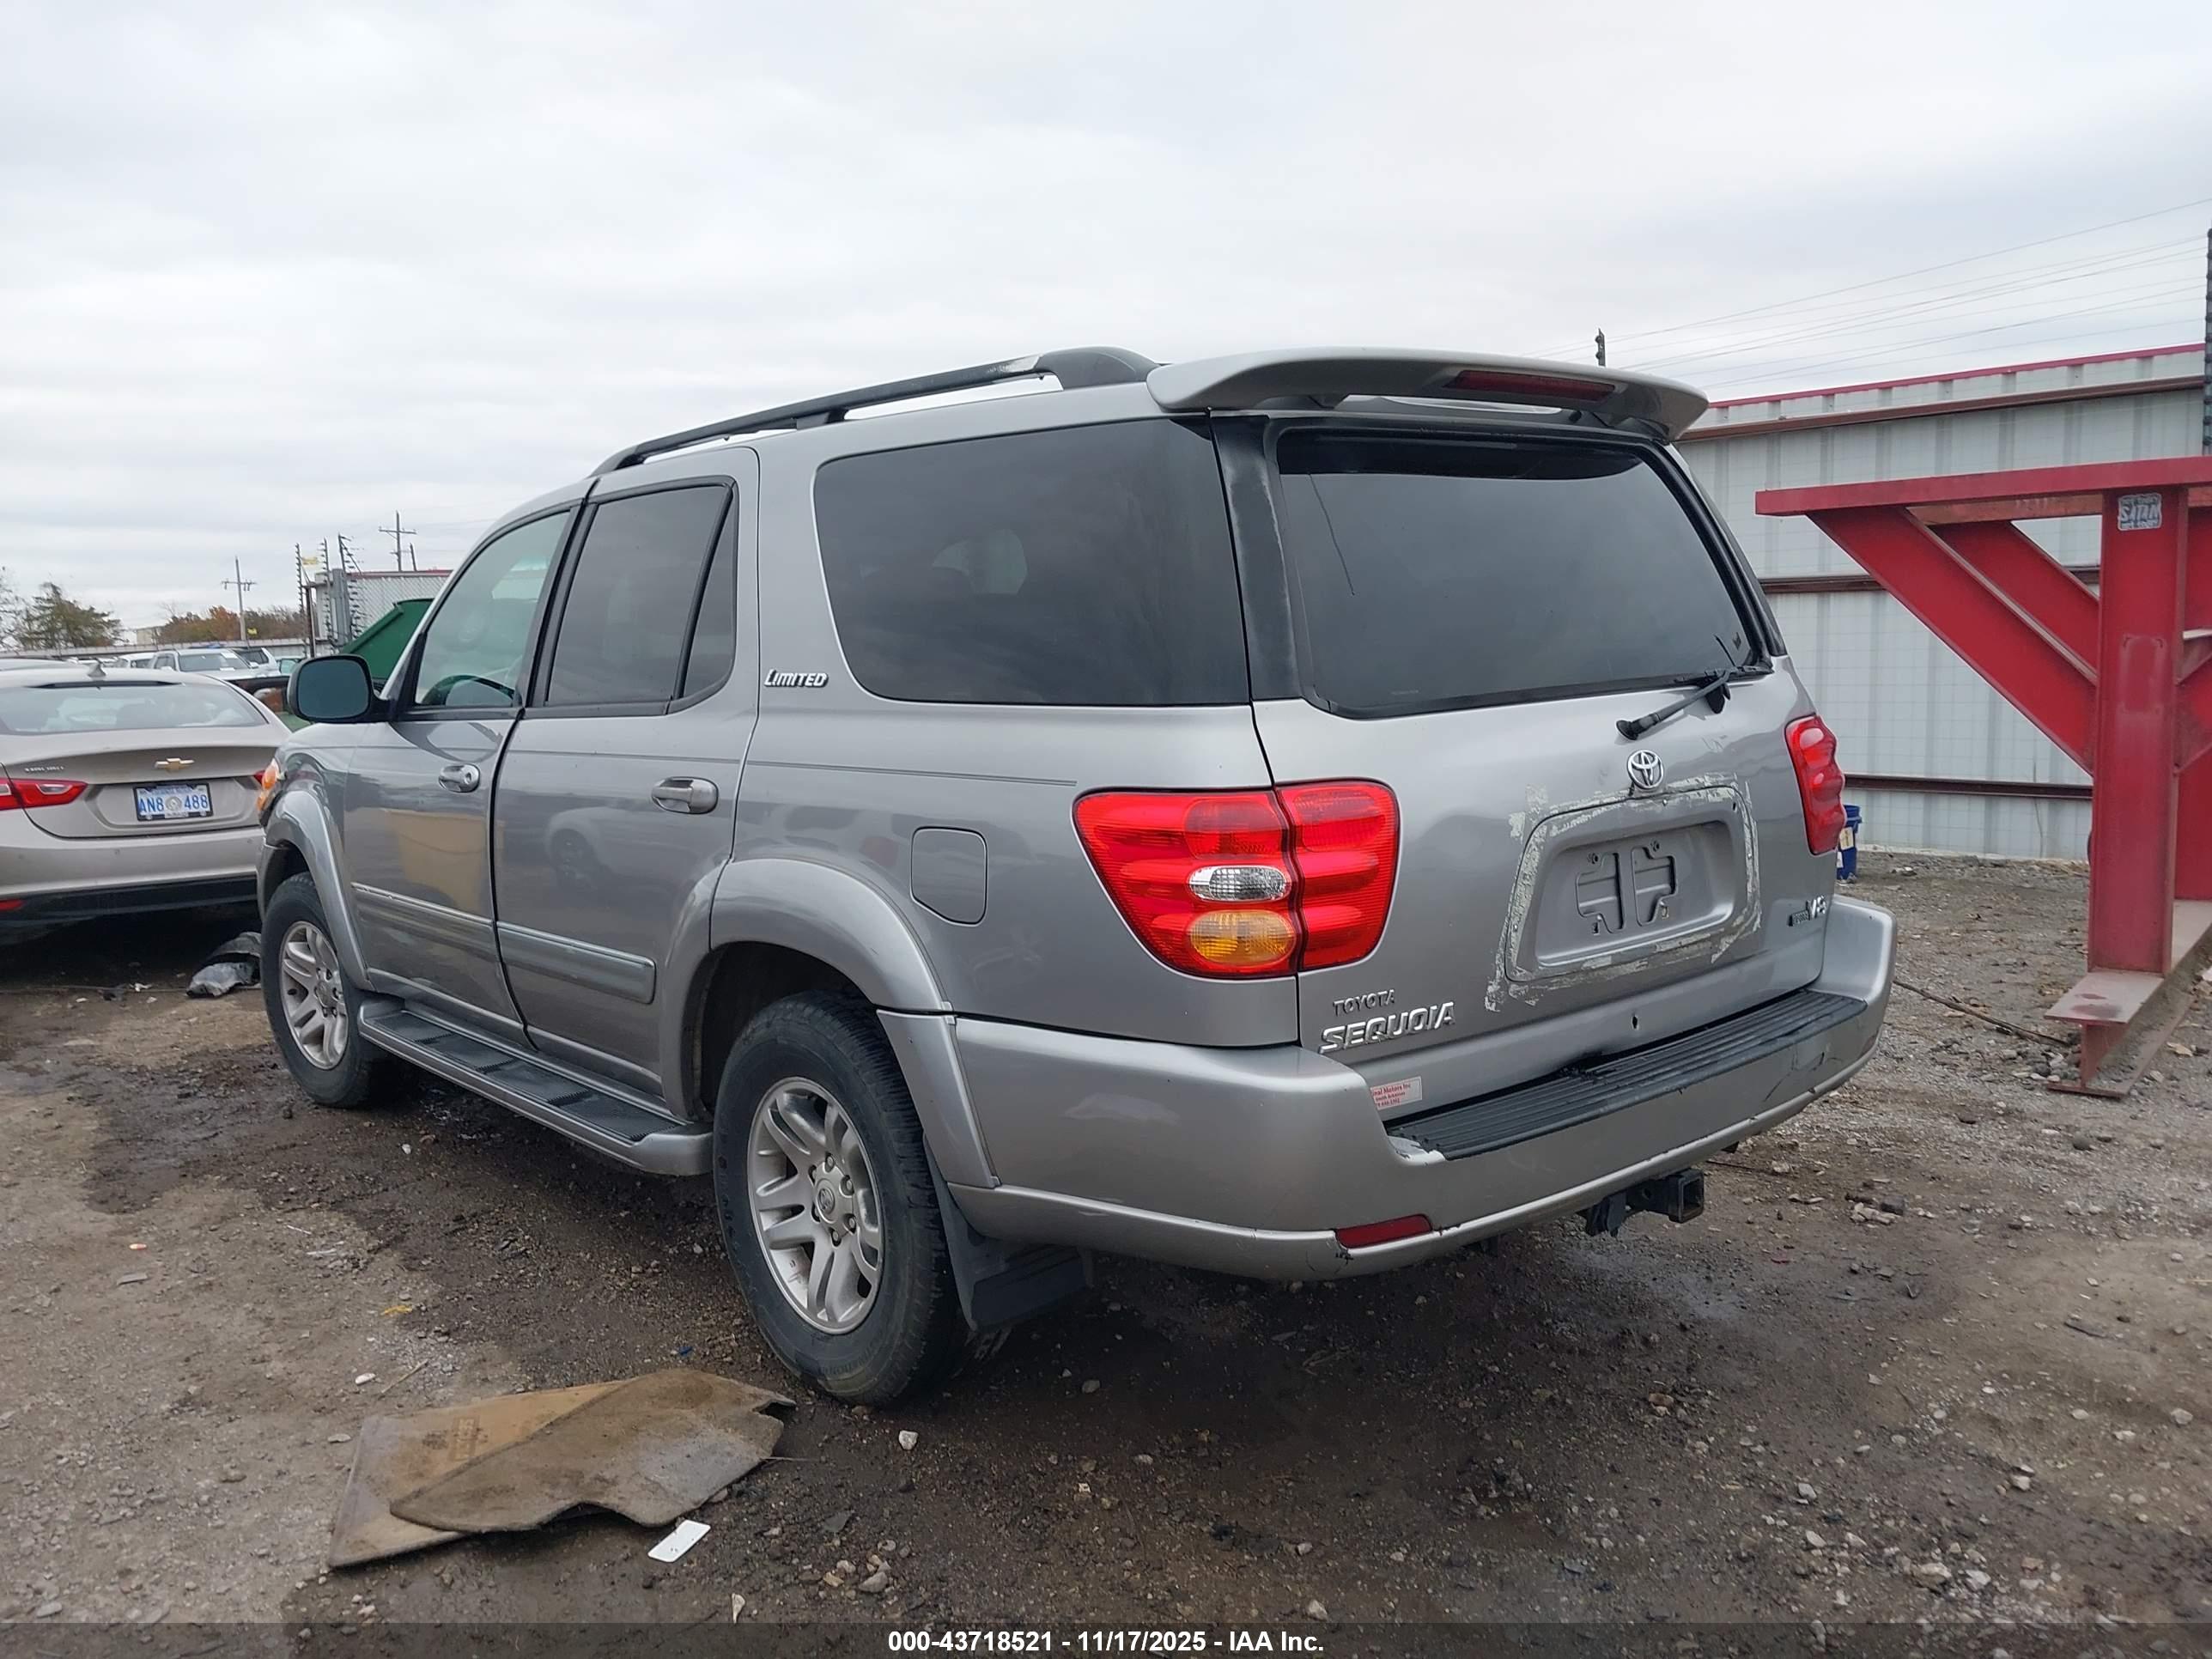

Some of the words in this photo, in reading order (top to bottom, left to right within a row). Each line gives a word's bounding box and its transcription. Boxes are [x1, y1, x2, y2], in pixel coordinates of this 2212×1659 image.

[138, 797, 164, 813] AN8
[185, 794, 209, 810] 488
[1332, 989, 1395, 1017] TOYOTA
[1319, 1001, 1456, 1054] SEQUOIA
[1383, 1085, 1403, 1094] Motors
